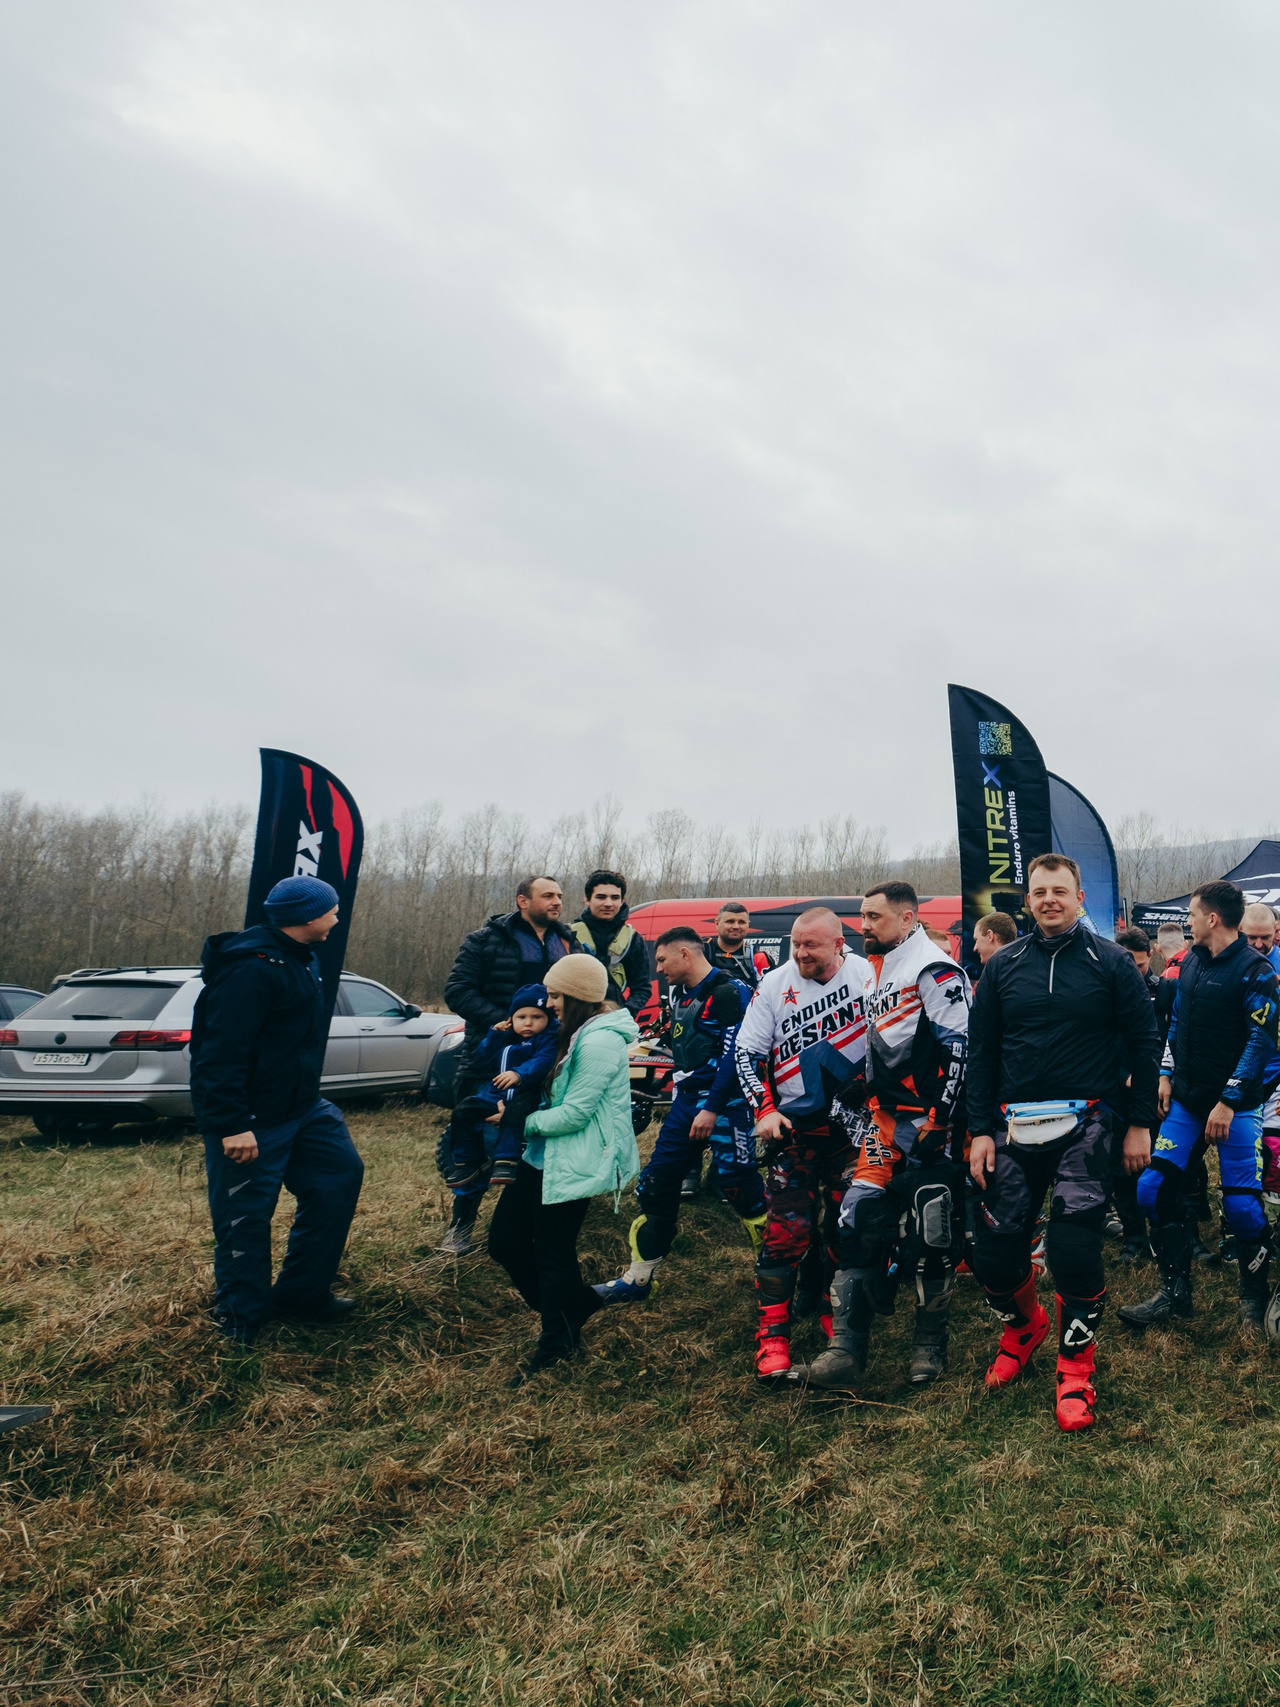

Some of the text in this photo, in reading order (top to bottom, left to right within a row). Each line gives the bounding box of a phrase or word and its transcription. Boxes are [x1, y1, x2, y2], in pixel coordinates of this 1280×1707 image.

[981, 760, 1011, 884] NITREX
[1006, 791, 1023, 884] Enduro vitamins
[1142, 912, 1190, 921] SHAR
[781, 983, 851, 1036] ENDURO
[633, 1055, 675, 1064] SHARMA
